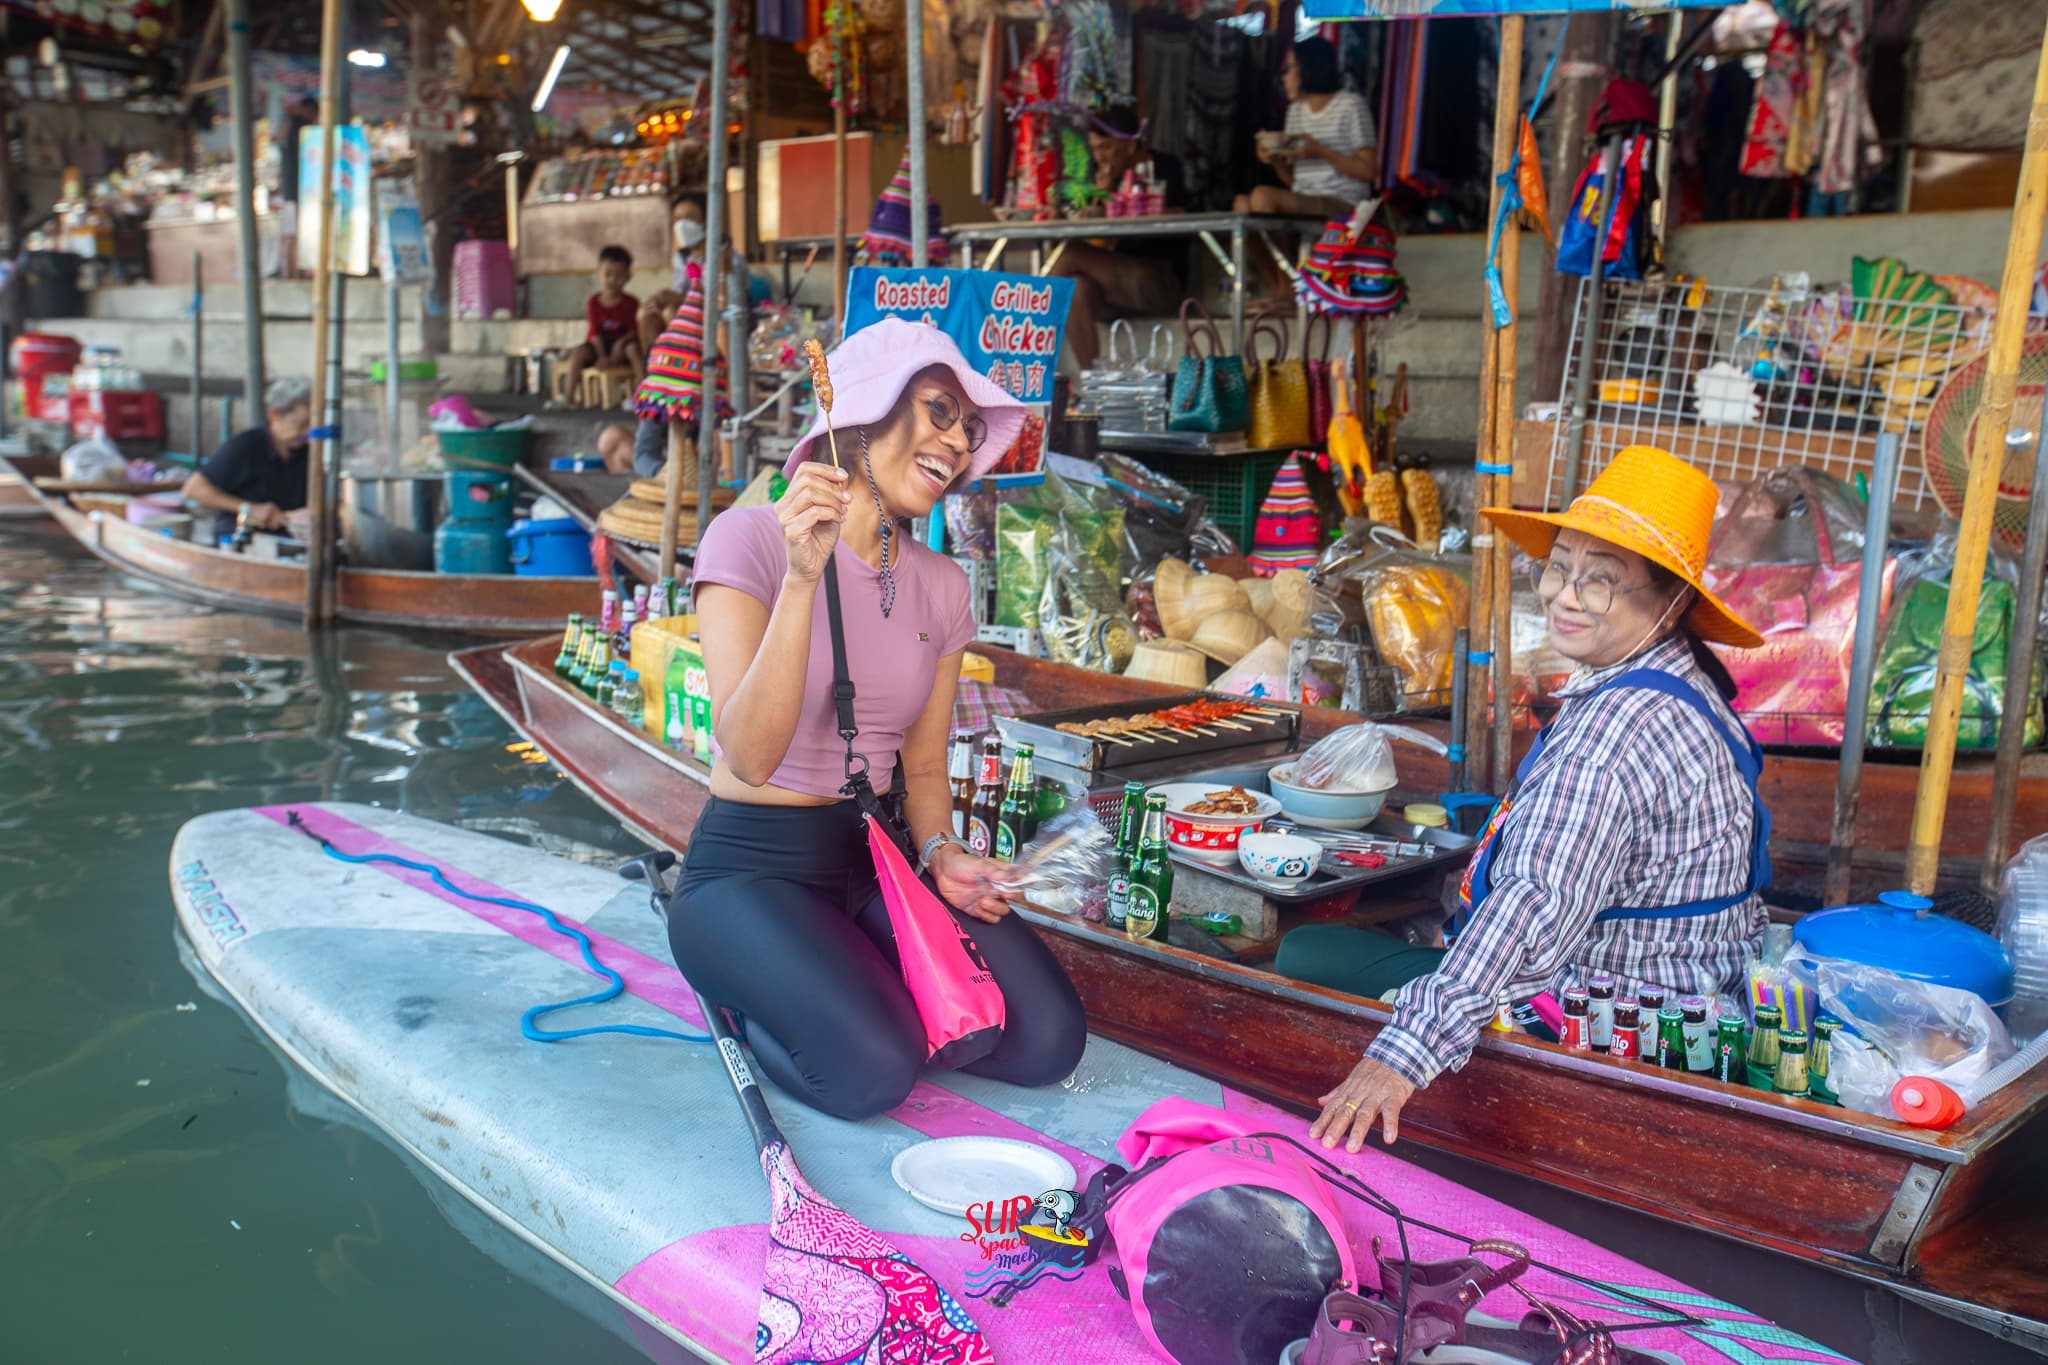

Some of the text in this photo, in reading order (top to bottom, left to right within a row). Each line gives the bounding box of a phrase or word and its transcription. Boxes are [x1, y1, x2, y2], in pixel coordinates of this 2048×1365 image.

[875, 276, 950, 309] Roasted
[992, 283, 1051, 315] Grilled
[980, 315, 1056, 354] Chicken
[685, 667, 712, 700] SM
[178, 860, 247, 951] NAISH
